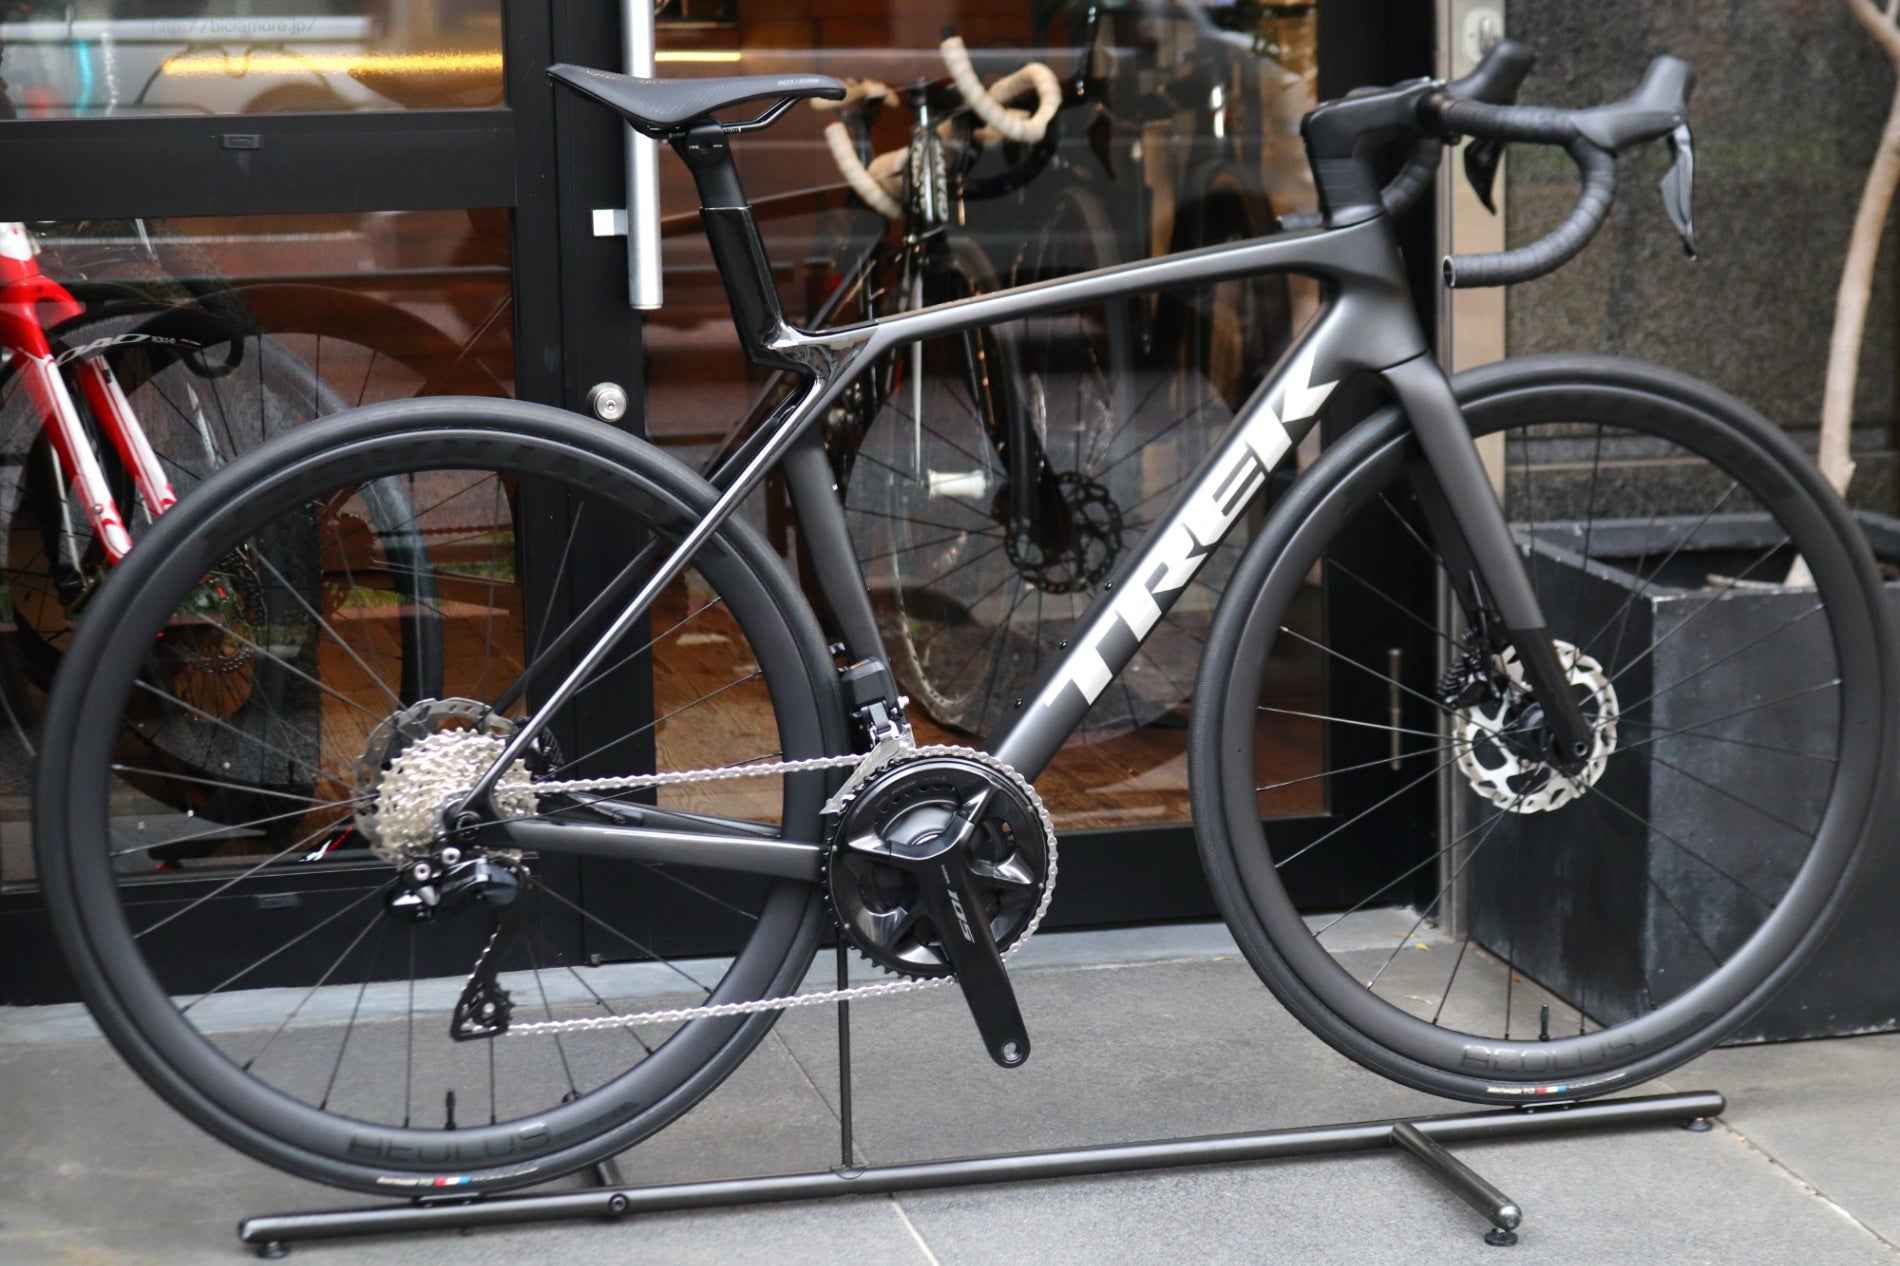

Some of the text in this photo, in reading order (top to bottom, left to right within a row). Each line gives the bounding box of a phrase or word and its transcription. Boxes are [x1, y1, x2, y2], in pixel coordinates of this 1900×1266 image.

[55, 333, 151, 367] OAD
[1043, 344, 1340, 707] TREK
[947, 889, 975, 943] 105
[1461, 1035, 1637, 1073] AEOLUS
